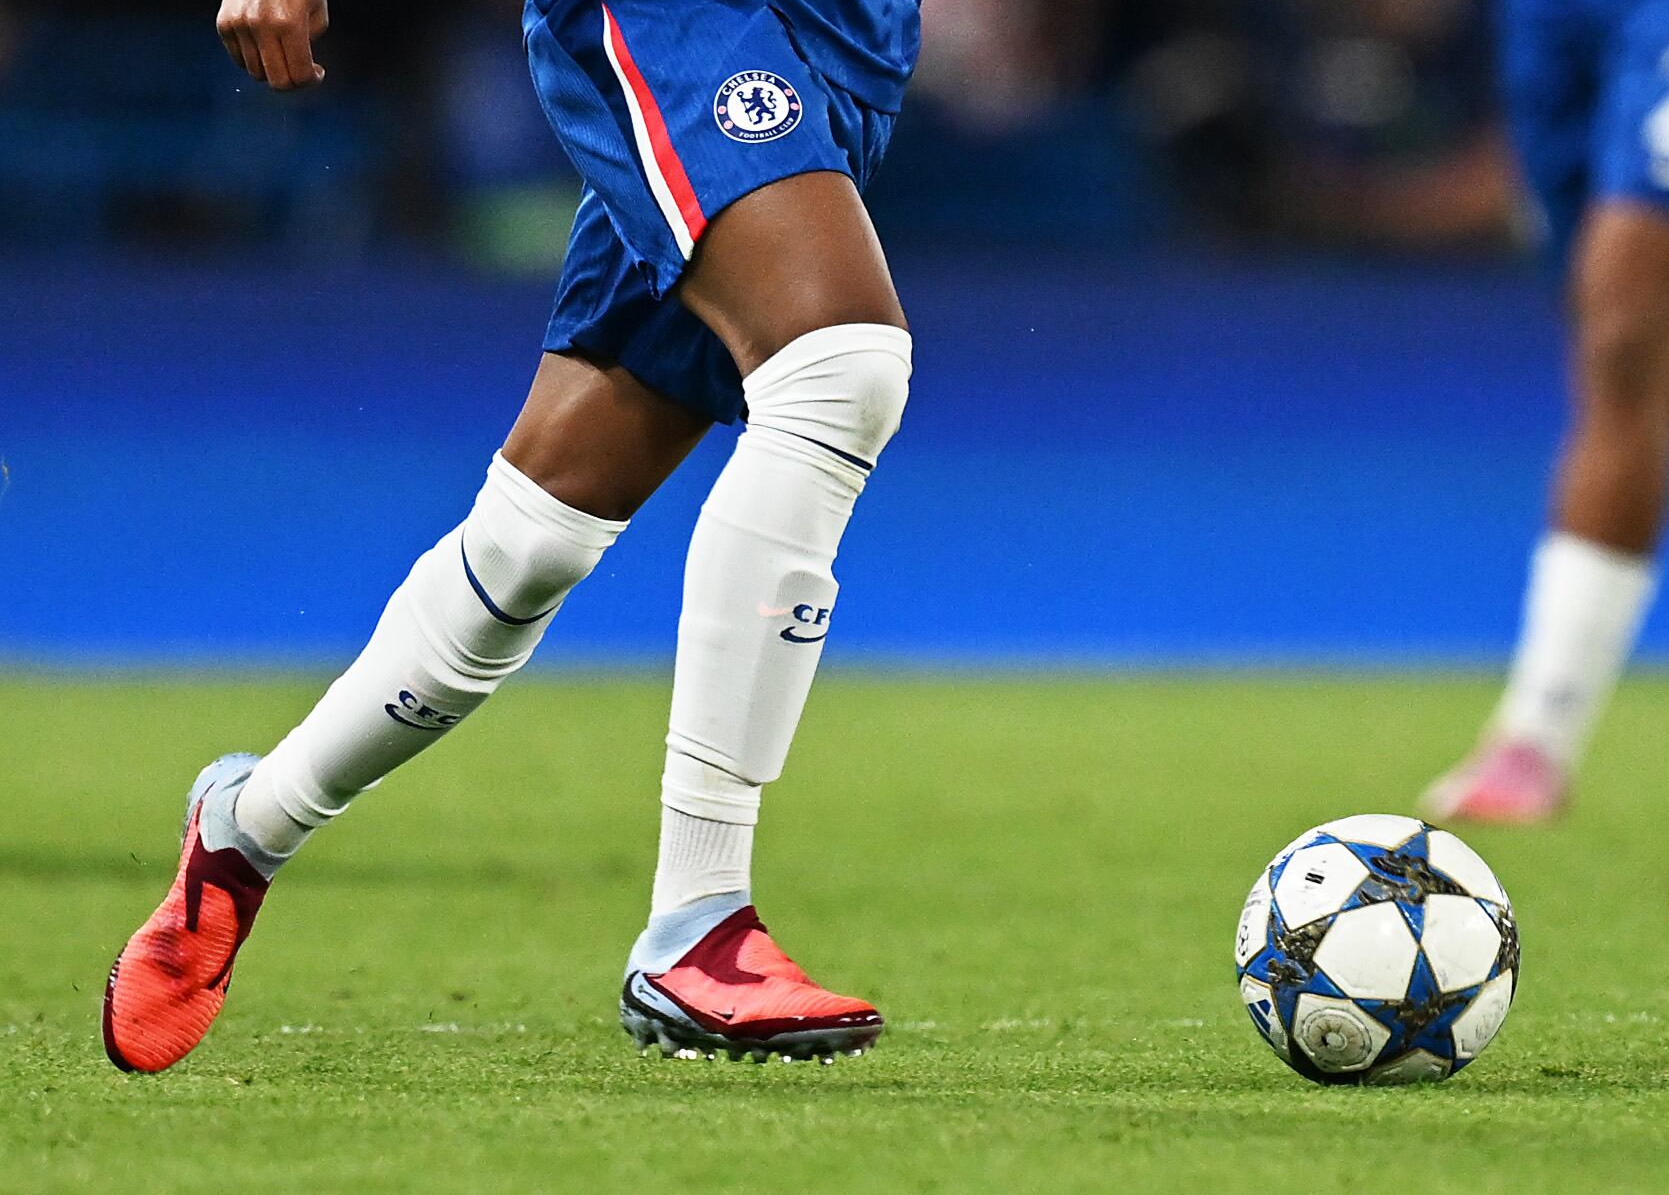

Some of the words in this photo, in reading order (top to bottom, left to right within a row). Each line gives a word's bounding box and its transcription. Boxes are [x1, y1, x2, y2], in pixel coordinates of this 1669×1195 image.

[721, 72, 776, 96] CHELSEA
[738, 129, 777, 140] FOOTBALL
[792, 603, 832, 625] CF
[398, 689, 461, 725] CFC
